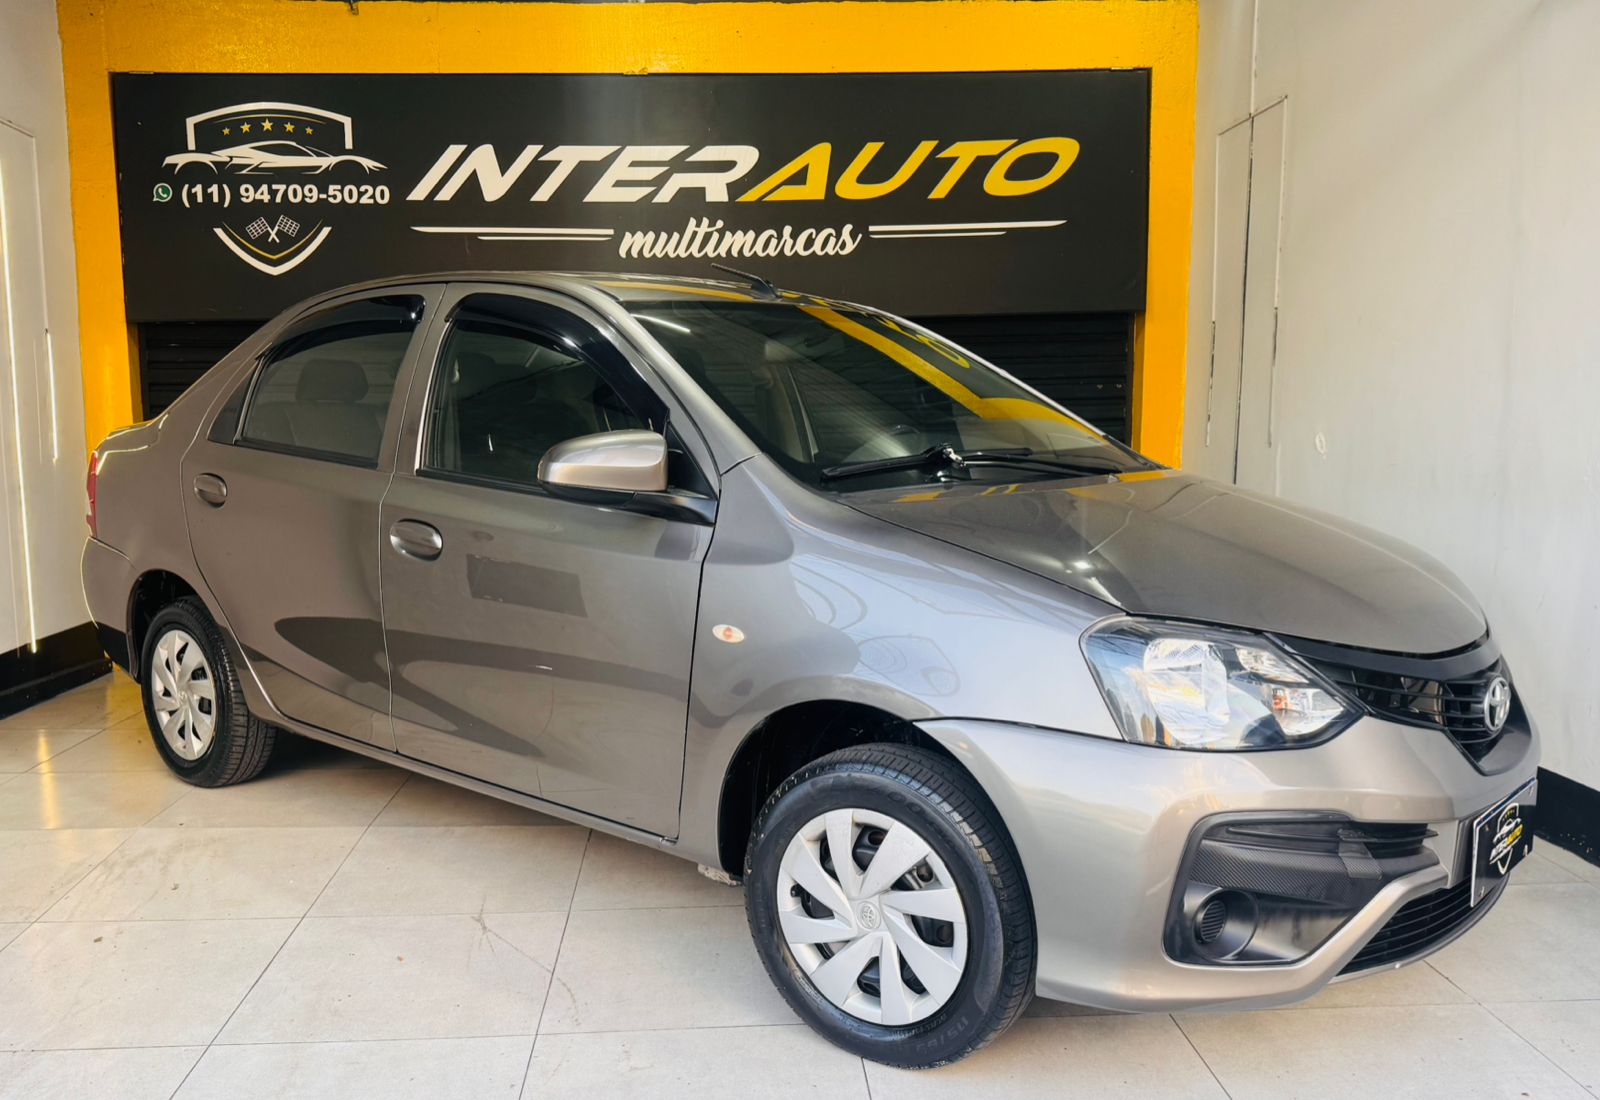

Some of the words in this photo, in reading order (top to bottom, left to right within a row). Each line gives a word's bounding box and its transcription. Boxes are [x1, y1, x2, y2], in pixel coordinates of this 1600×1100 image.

[406, 137, 1080, 203] INTERAUTO
[182, 184, 230, 207] (11)
[240, 184, 390, 204] 94709-5020
[619, 217, 862, 258] multimarcas
